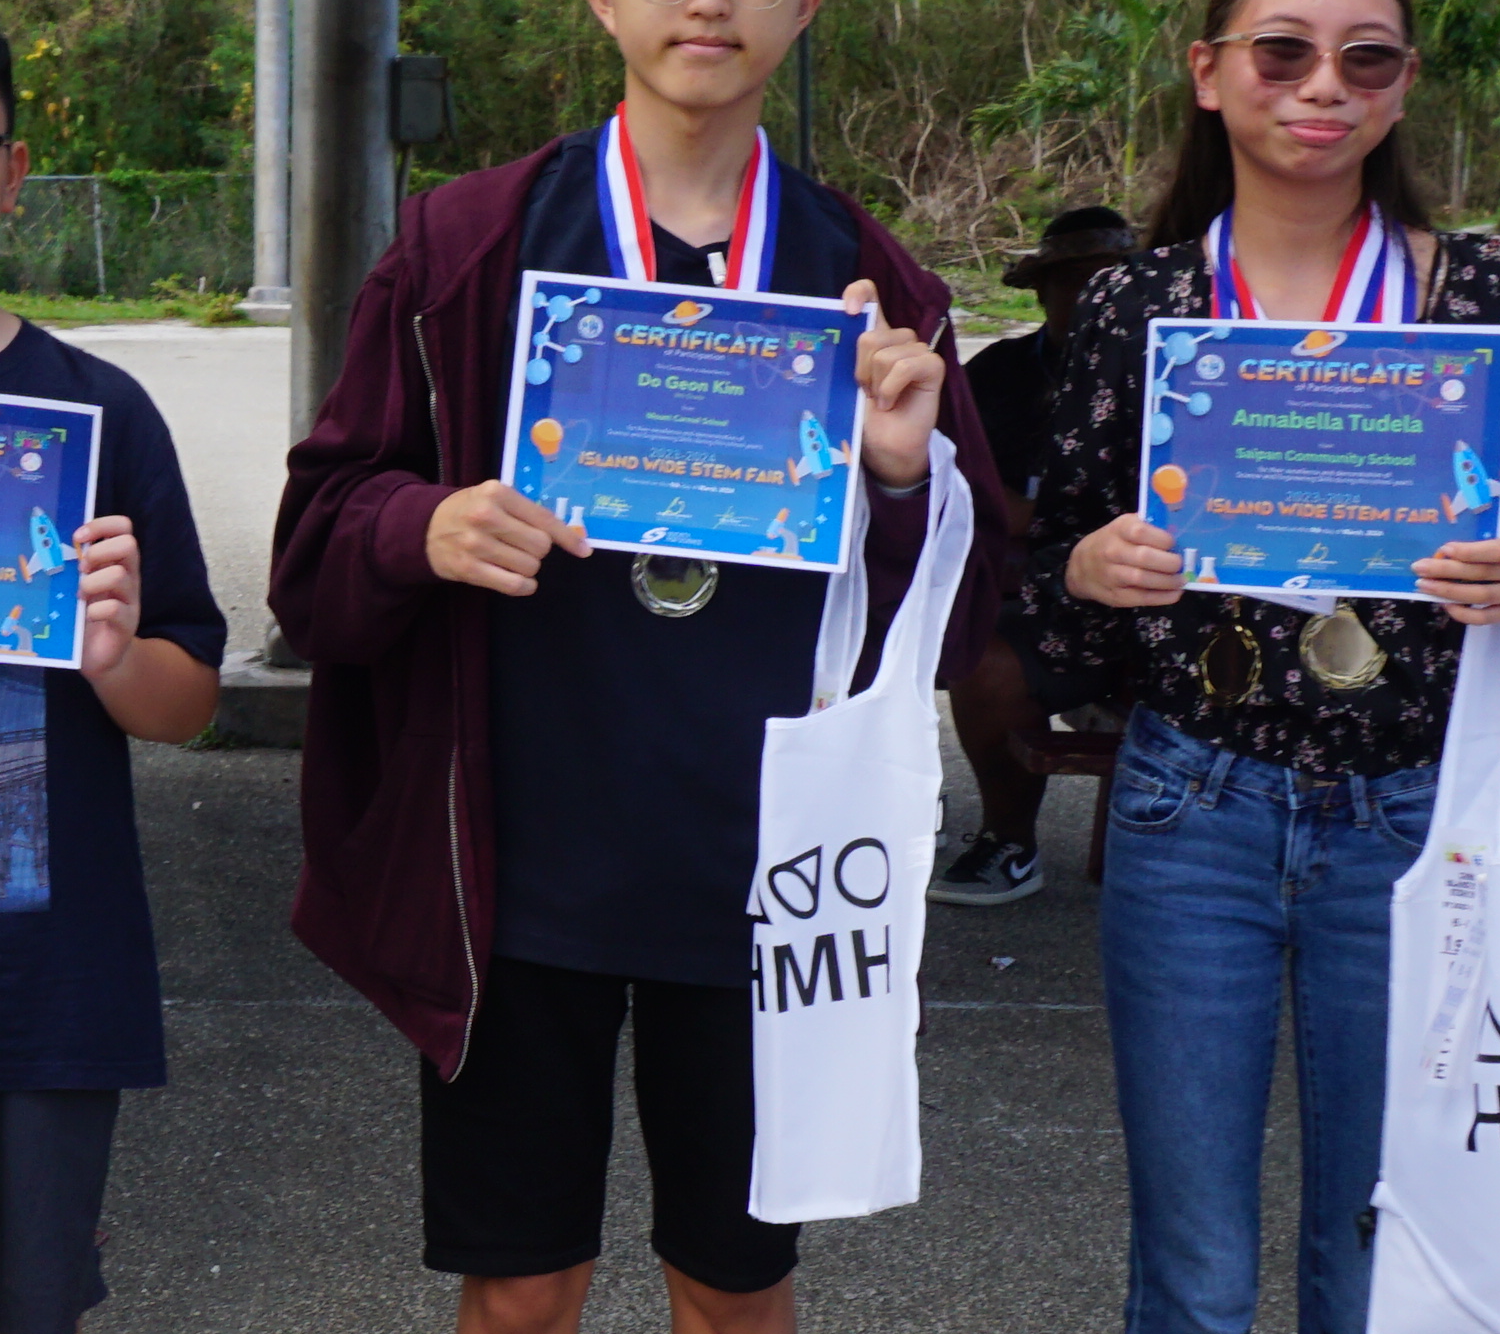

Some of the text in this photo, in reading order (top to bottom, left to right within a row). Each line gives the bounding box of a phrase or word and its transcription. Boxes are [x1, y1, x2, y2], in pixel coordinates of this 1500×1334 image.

[614, 323, 780, 357] CERTIFICATE
[637, 373, 662, 389] Do
[664, 376, 708, 392] Geon
[712, 380, 744, 396] Kim
[1238, 359, 1425, 385] CERTIFICATE
[1232, 409, 1423, 434] Annabella Tudela
[578, 451, 785, 485] ISLAND WIDE STEM FAIR
[1235, 447, 1416, 467] Saipan Community School
[1205, 498, 1440, 524] ISLAND WIDE STEM FAIR
